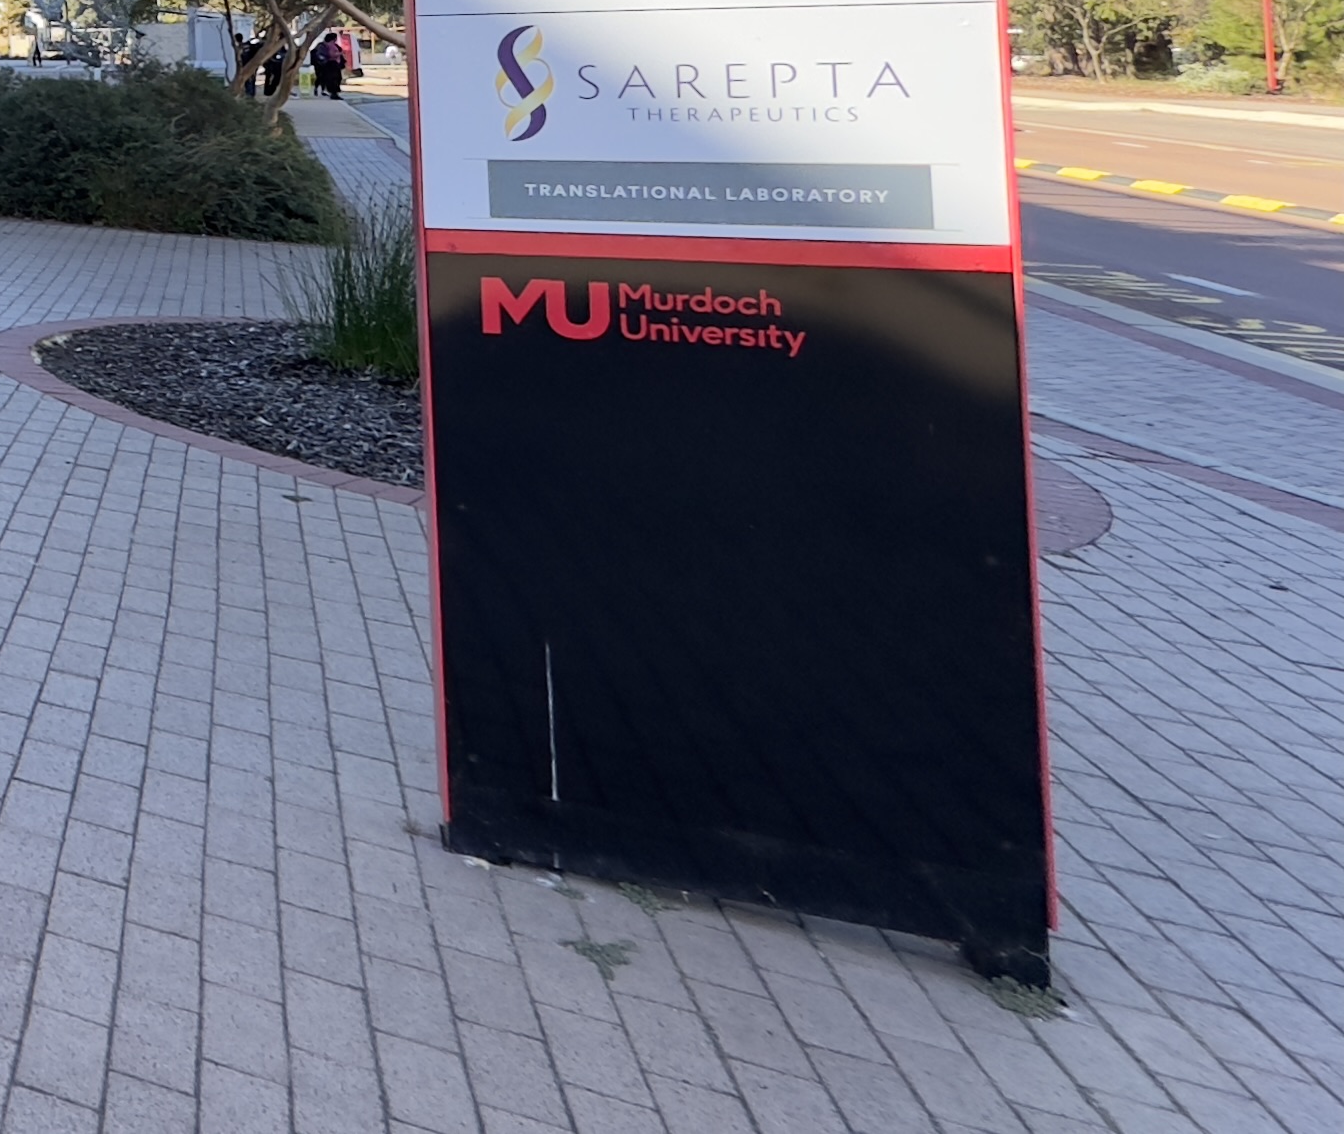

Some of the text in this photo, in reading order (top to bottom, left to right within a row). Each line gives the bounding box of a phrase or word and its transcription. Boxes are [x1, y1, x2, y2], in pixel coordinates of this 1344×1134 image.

[577, 62, 910, 100] SAREPTA
[626, 106, 859, 123] THERAPEUTICS
[524, 182, 890, 204] TRANSLATIONAL LABORATORY
[481, 276, 610, 340] MU
[618, 283, 782, 317] Murdoch
[619, 314, 806, 357] University
